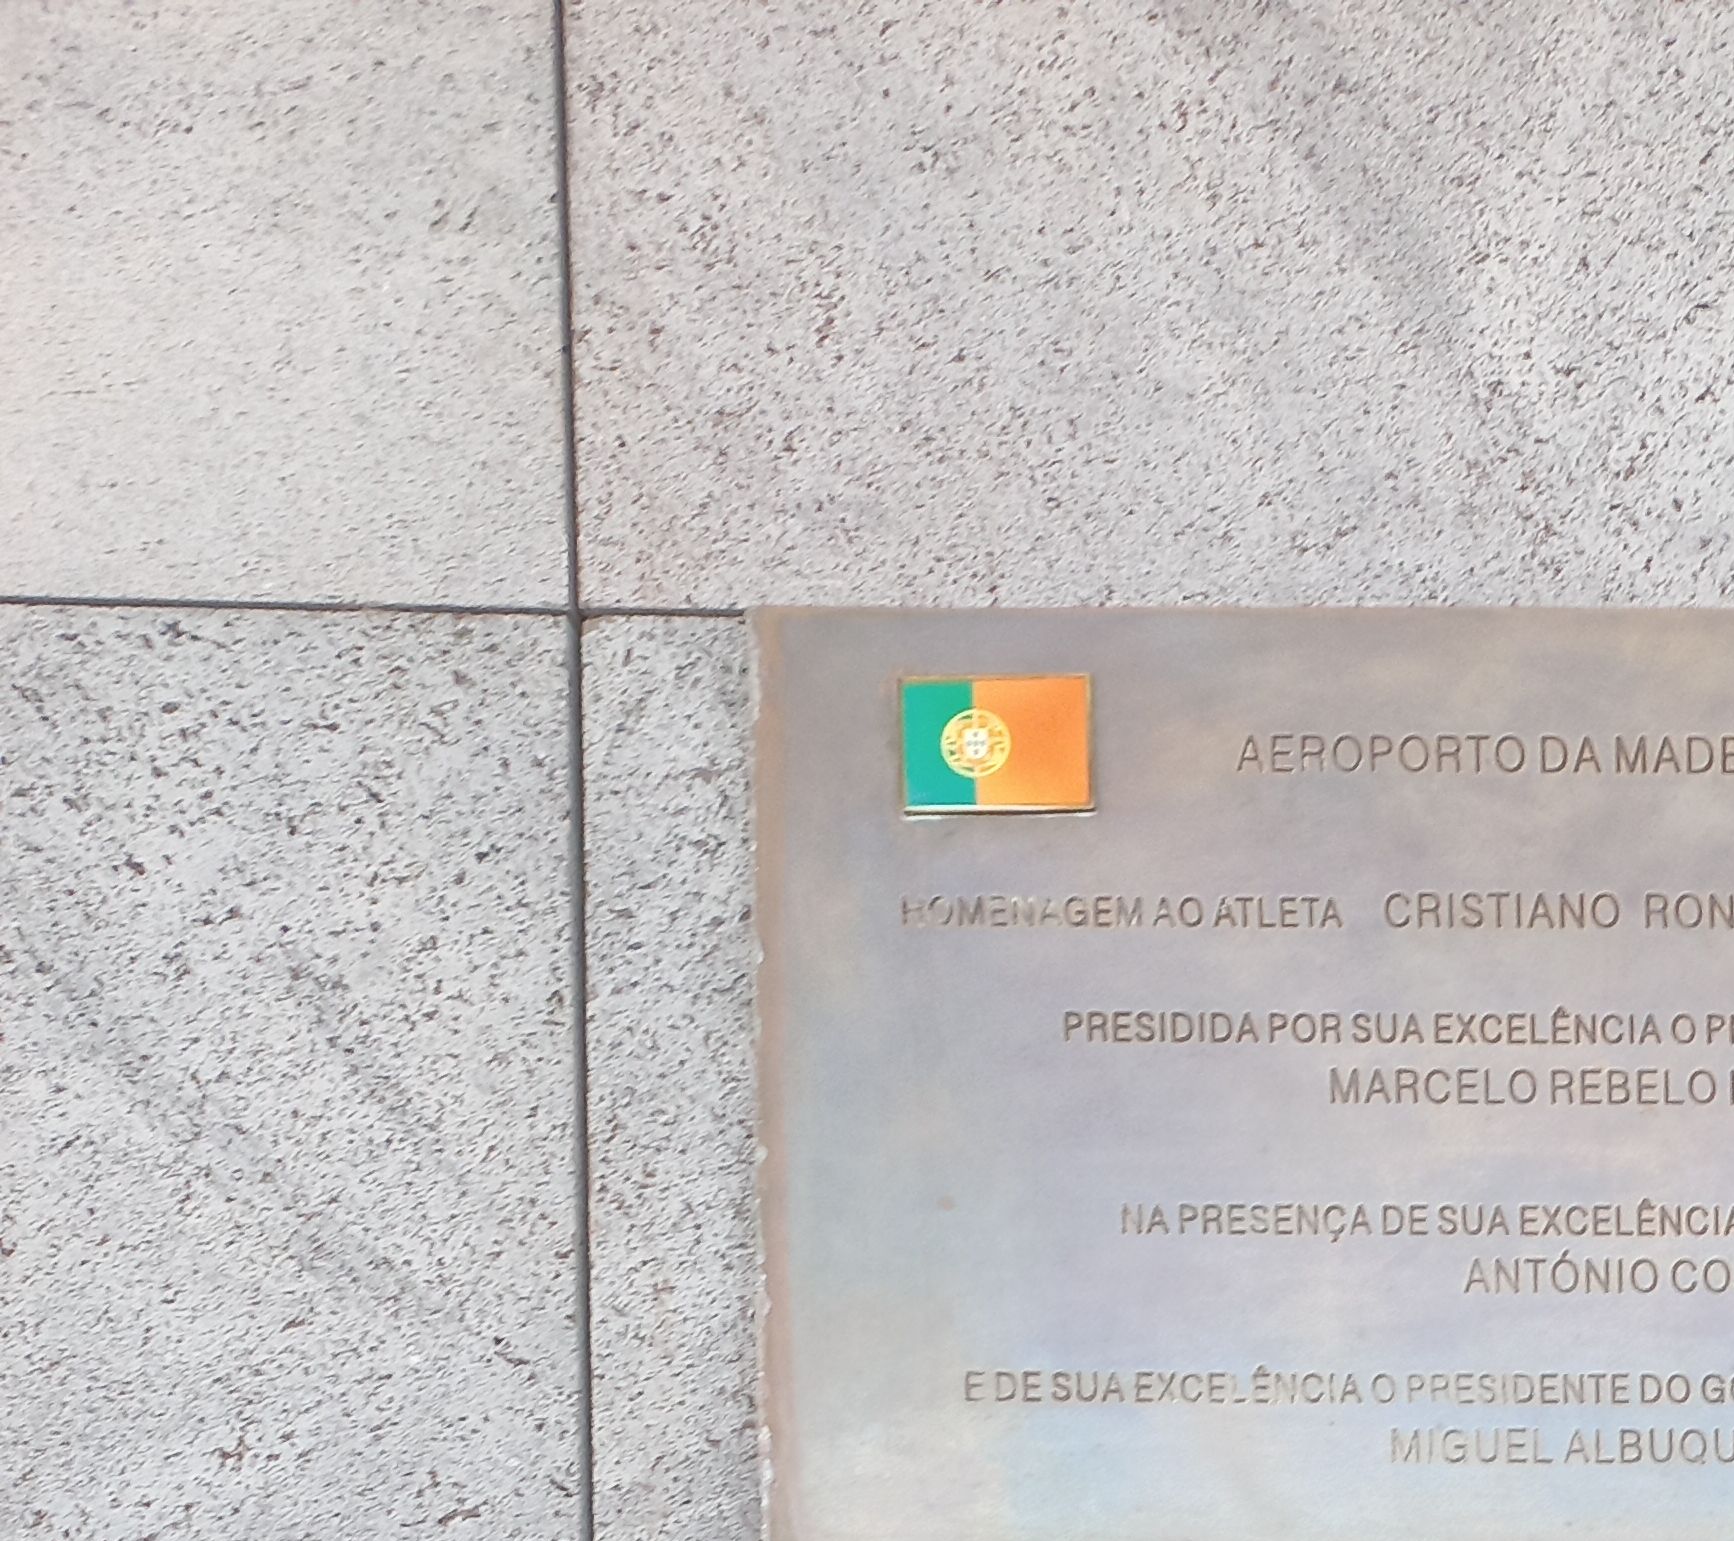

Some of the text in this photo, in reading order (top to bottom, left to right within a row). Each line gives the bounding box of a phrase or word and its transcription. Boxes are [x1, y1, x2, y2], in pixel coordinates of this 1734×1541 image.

[1236, 734, 1526, 776] AEROPORTO
[1538, 734, 1604, 775] DA
[901, 895, 1142, 928] HOMENAGEM
[1152, 896, 1203, 928] AO
[1213, 896, 1343, 929] ATLETA
[1384, 893, 1620, 931] CRISTIANO
[1063, 1011, 1259, 1045] PRESIDIDA
[1267, 1011, 1342, 1045] POR
[1350, 1012, 1424, 1045] SUA
[1433, 1006, 1661, 1046] EXCELÊNCIA
[1670, 1013, 1697, 1046] O
[1329, 1067, 1537, 1105] MARCELO
[1550, 1068, 1717, 1106] REBELO
[1122, 1204, 1170, 1236] NA
[1178, 1204, 1372, 1243] PRESENÇA
[1381, 1204, 1429, 1236] DE
[1437, 1204, 1510, 1237] SUA
[1463, 1250, 1659, 1295] ANTÓNIO
[964, 1371, 986, 1403] E
[994, 1371, 1043, 1403] DE
[1051, 1371, 1126, 1404] SUA
[1134, 1365, 1362, 1404] EXCELÊNCIA
[1371, 1371, 1396, 1404] O
[1405, 1372, 1630, 1404] PRESIDENTE
[1639, 1372, 1692, 1404] DO
[1389, 1426, 1552, 1465] MIGUEL
